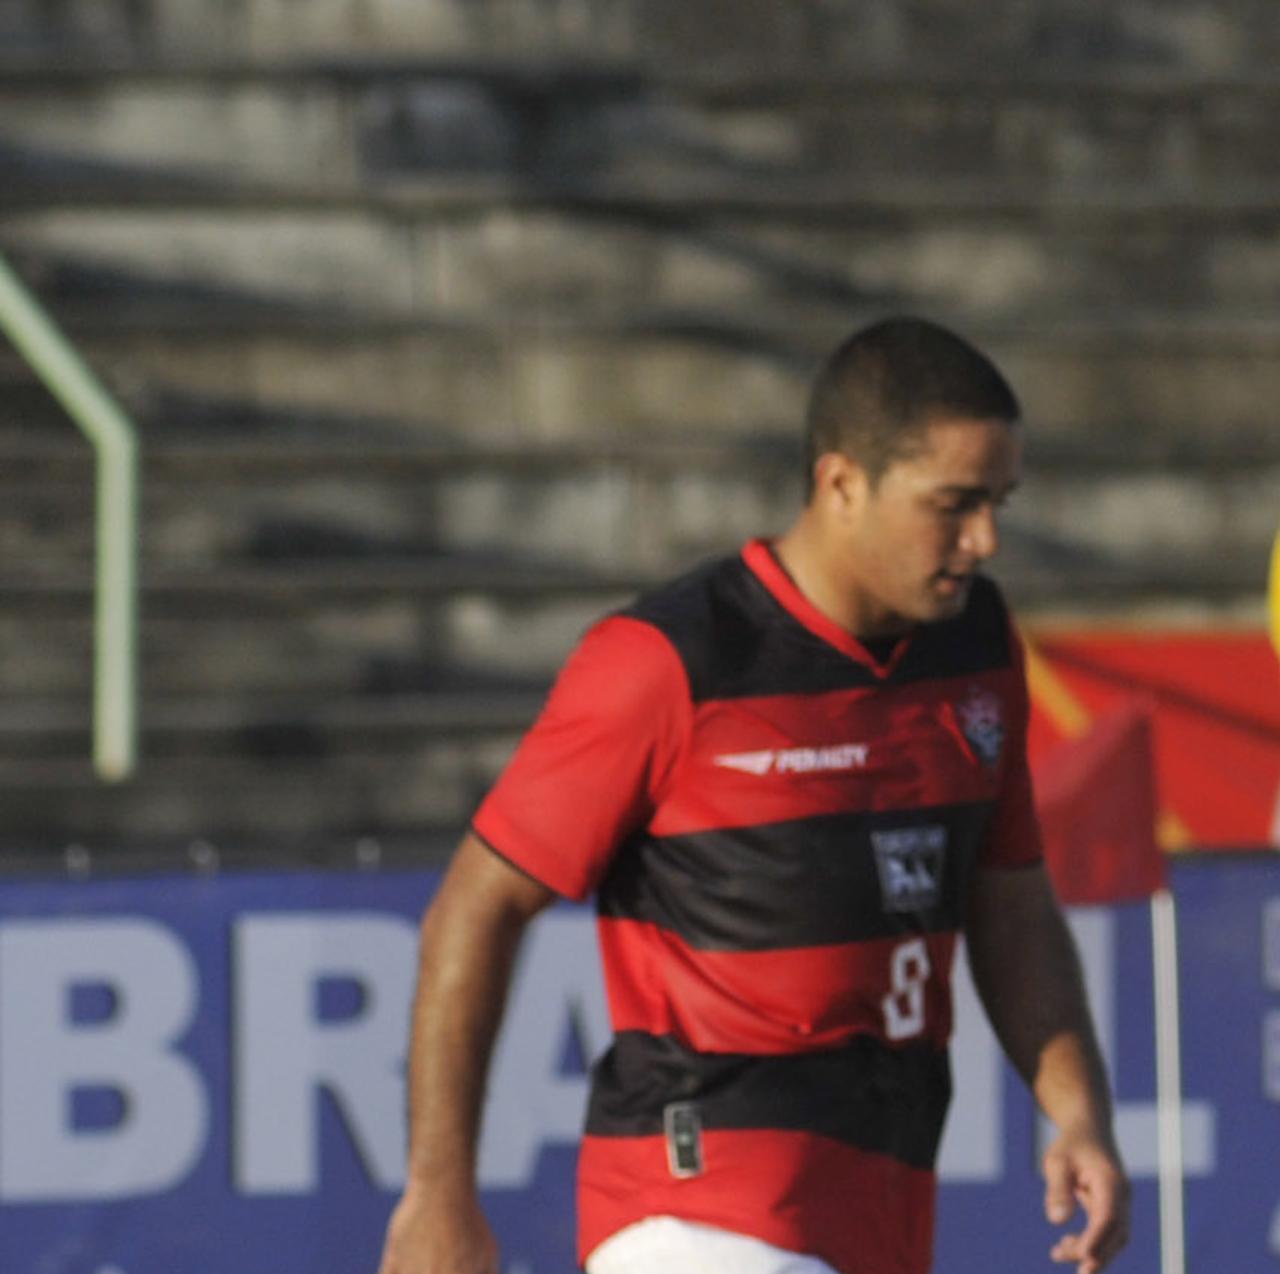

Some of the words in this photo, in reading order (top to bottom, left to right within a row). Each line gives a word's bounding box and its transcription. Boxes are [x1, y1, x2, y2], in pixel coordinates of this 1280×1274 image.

[777, 743, 868, 775] PENALTY
[884, 938, 930, 1042] 8
[0, 905, 1216, 1202] BRAIL
